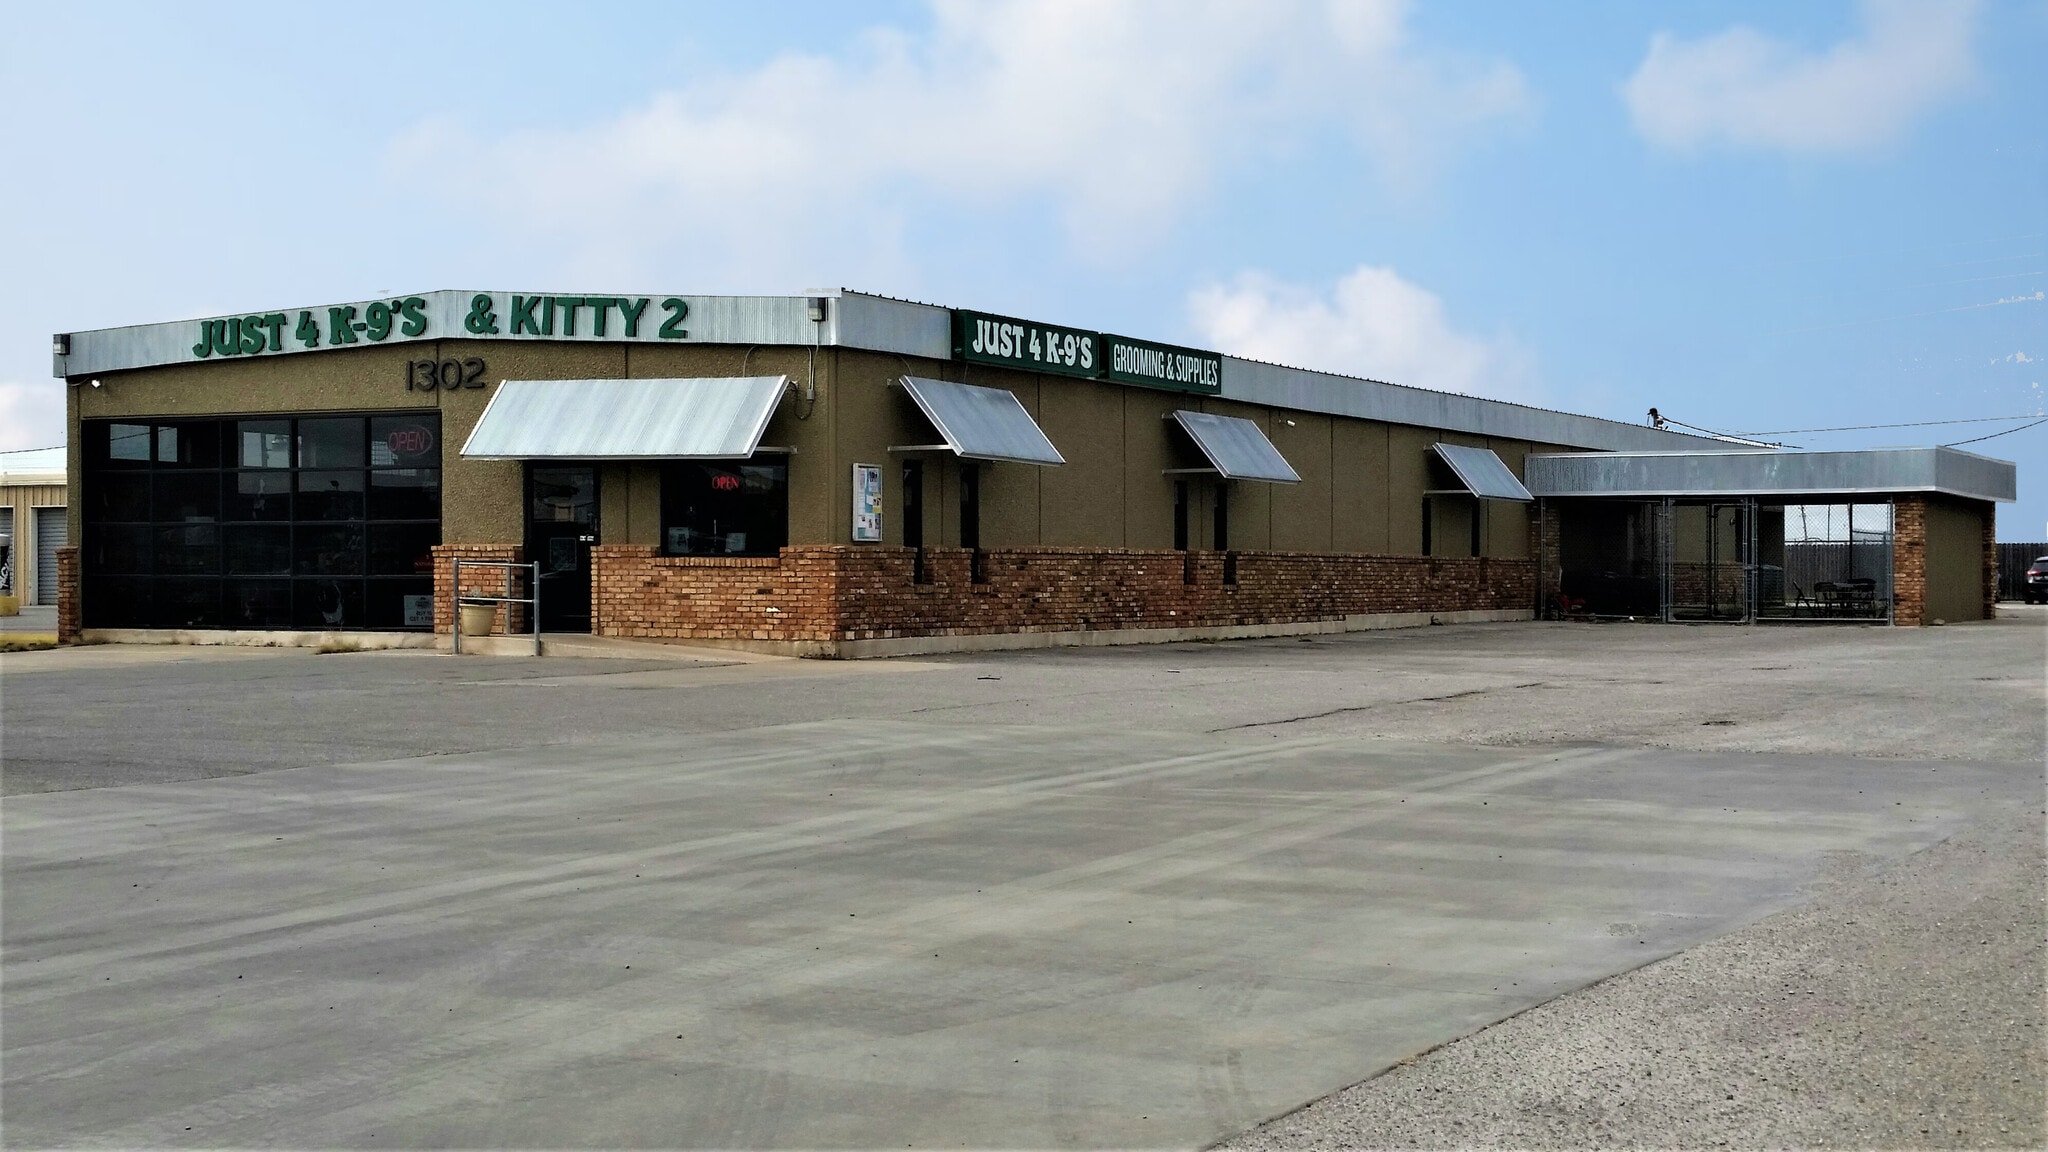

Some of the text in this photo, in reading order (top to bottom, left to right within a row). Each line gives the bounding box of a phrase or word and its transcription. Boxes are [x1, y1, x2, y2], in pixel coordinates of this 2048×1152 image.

[192, 294, 689, 358] JUST 4 K-9'S & KITTY 2
[972, 319, 1093, 369] JUST 4 K-9'S
[406, 357, 485, 391] 1302
[1113, 343, 1218, 387] GROOMING & SUPPLIES
[389, 431, 425, 451] OPEN
[712, 475, 739, 490] OPEN
